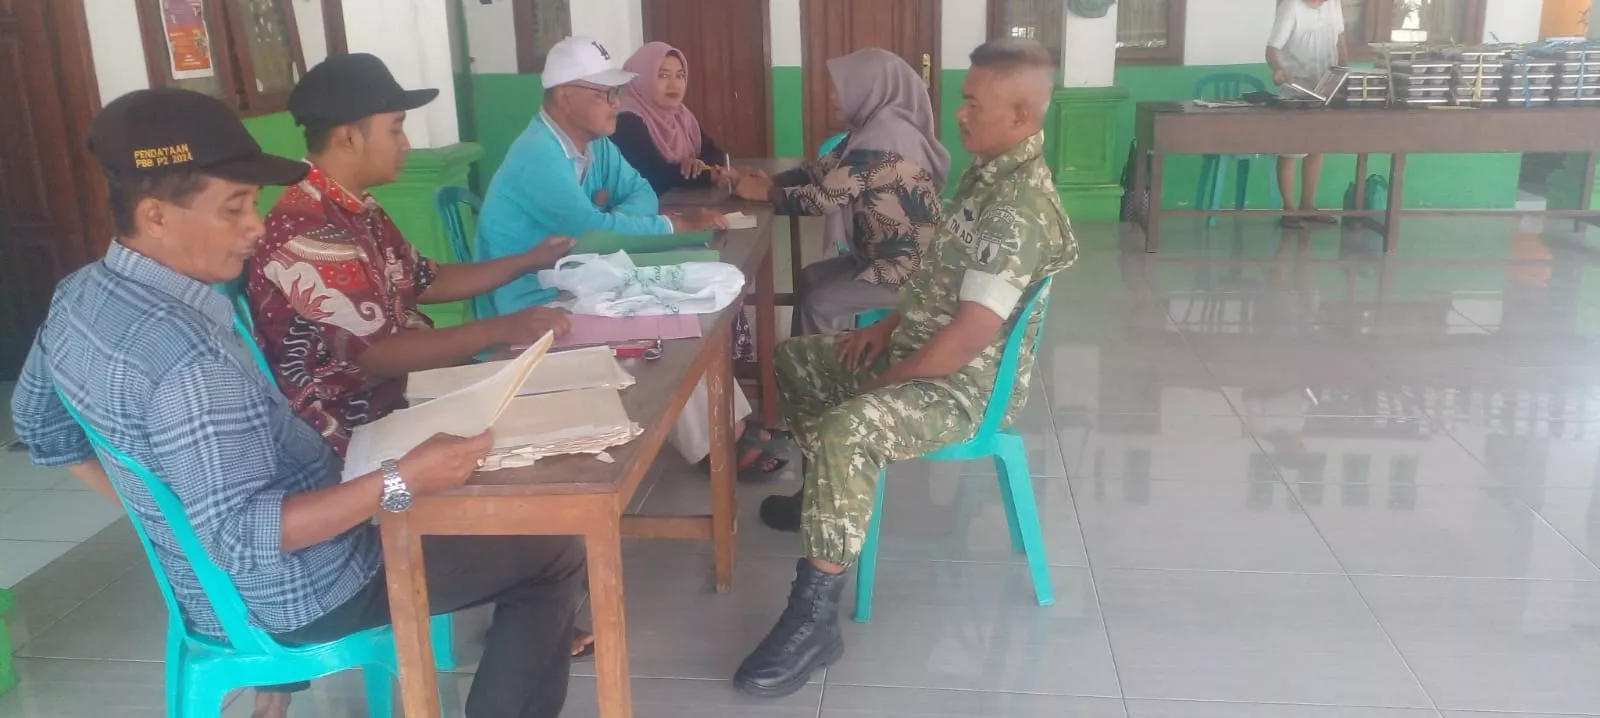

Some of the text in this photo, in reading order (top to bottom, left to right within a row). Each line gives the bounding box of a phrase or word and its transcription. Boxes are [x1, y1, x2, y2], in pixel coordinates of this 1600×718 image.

[134, 143, 188, 159] PENDATAAN
[136, 159, 154, 169] PBB
[960, 229, 973, 244] AD
